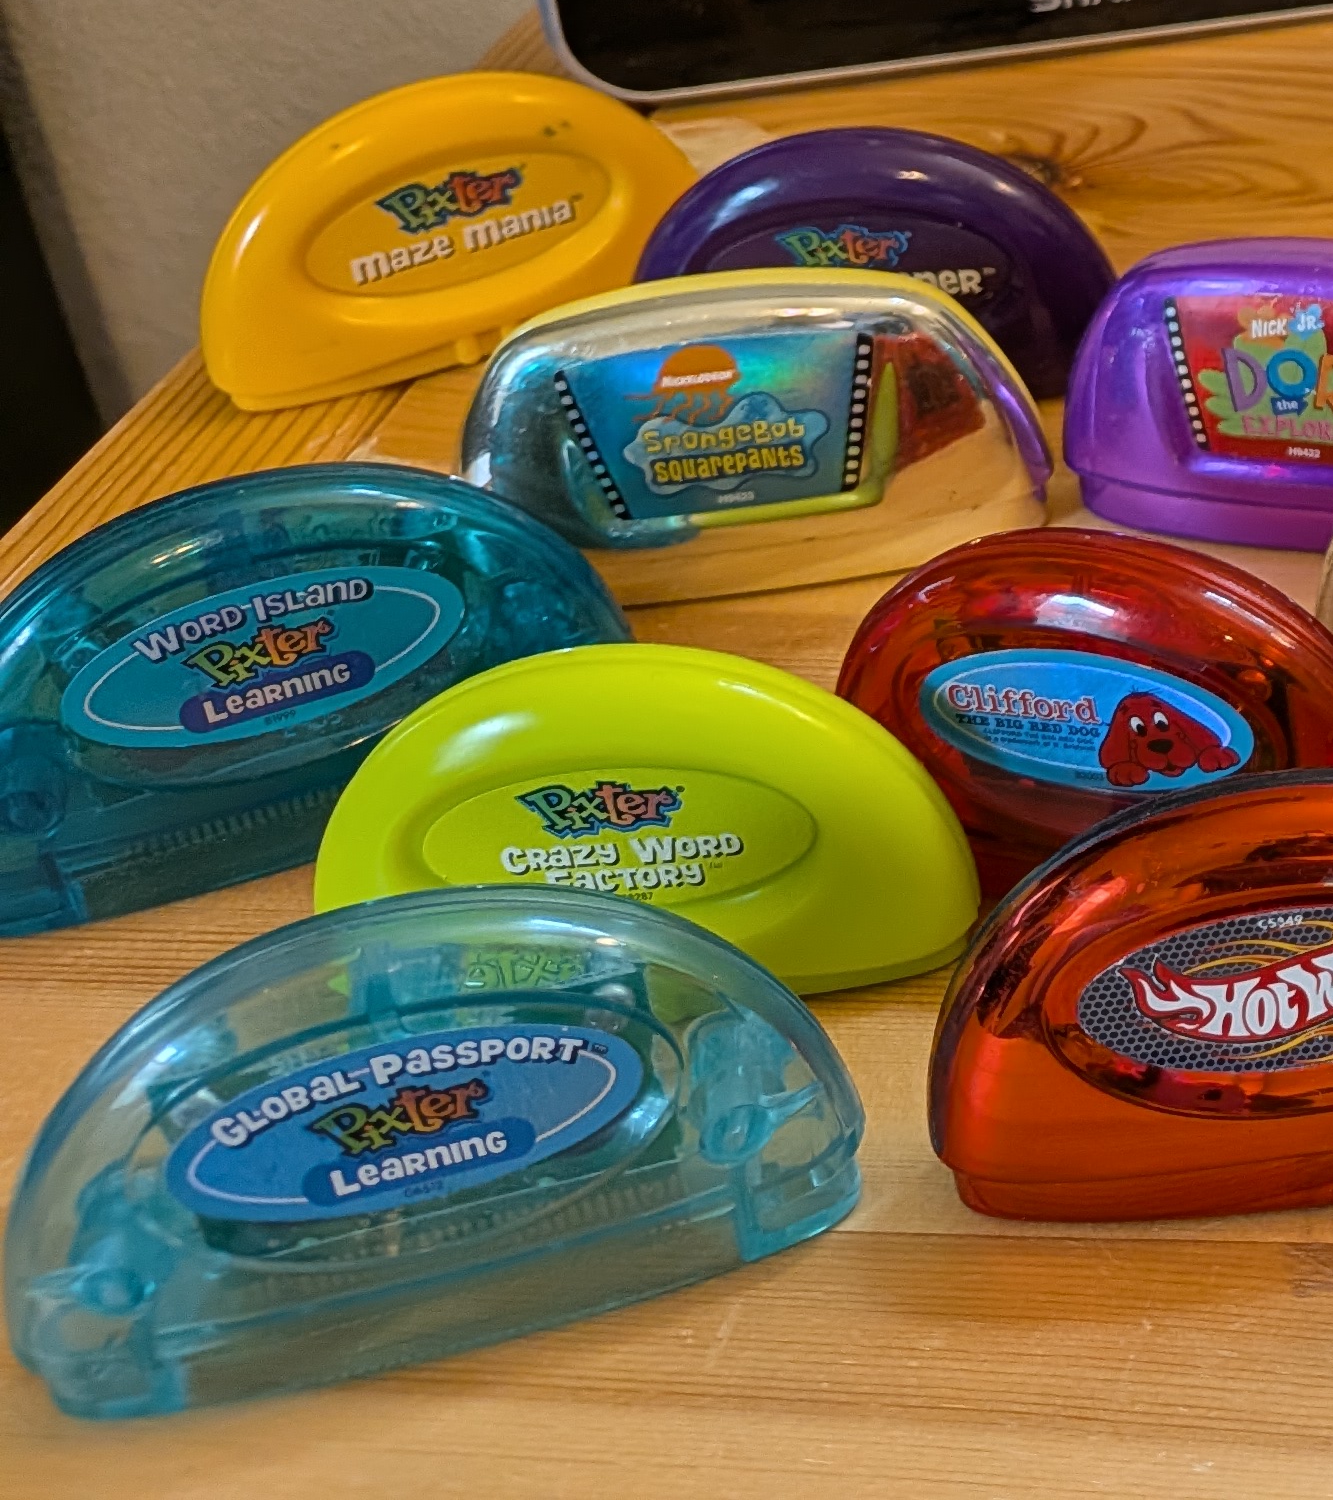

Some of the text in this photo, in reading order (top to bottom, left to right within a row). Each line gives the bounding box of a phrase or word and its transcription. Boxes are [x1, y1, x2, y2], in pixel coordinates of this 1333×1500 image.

[378, 169, 522, 232] Pixter
[779, 226, 905, 266] Pixter
[1252, 318, 1288, 338] NICK
[1276, 400, 1299, 411] the
[133, 604, 243, 662] WORD
[185, 618, 337, 687] Pixter
[202, 663, 351, 724] Learning
[947, 682, 1101, 724] Clifford
[955, 713, 990, 726] THE
[994, 717, 1024, 730] BIG
[1028, 720, 1063, 734] RED
[1067, 724, 1101, 738] DOG
[515, 782, 684, 838] Pixter
[633, 832, 744, 864] WORD
[312, 1079, 490, 1156] Pixter
[329, 1131, 507, 1197] Learning
